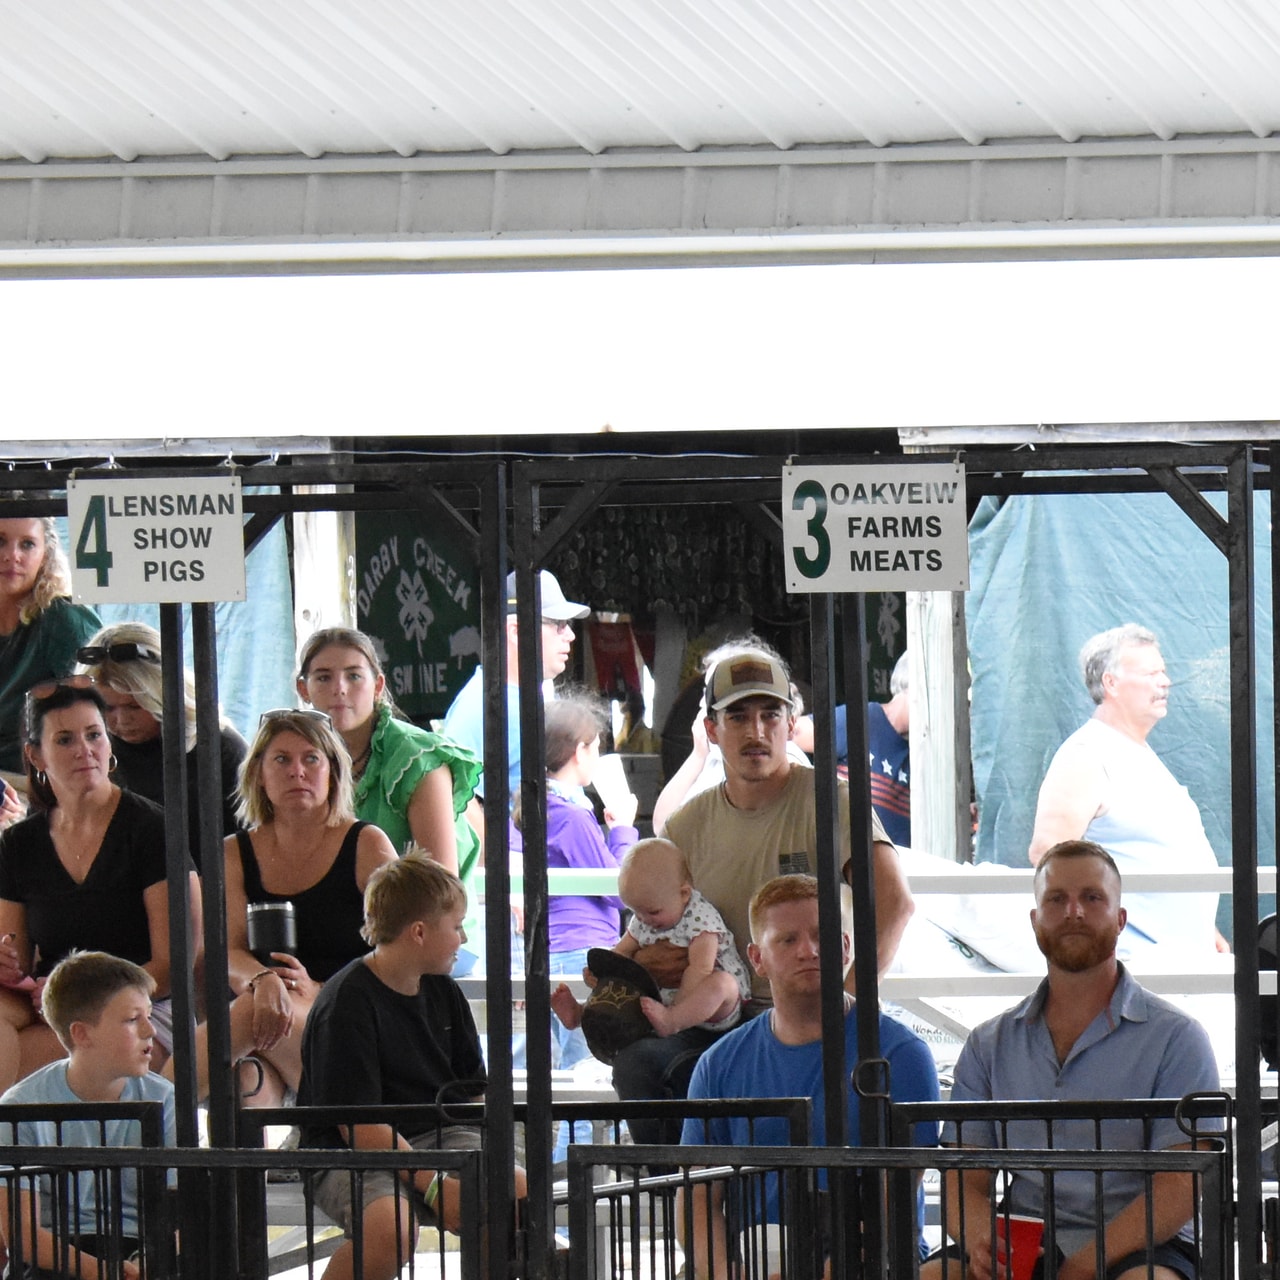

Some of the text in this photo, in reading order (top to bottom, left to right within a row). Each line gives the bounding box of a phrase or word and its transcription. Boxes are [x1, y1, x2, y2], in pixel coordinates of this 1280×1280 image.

[108, 493, 234, 517] LENSMAN
[830, 482, 958, 505] OAKVEIW
[133, 527, 212, 550] SHOW
[792, 480, 831, 579] 3
[848, 516, 942, 538] FARMS
[76, 495, 113, 587] 4
[144, 560, 205, 582] PIGS
[850, 549, 943, 572] MEATS
[357, 535, 471, 618] DARBY CREEK
